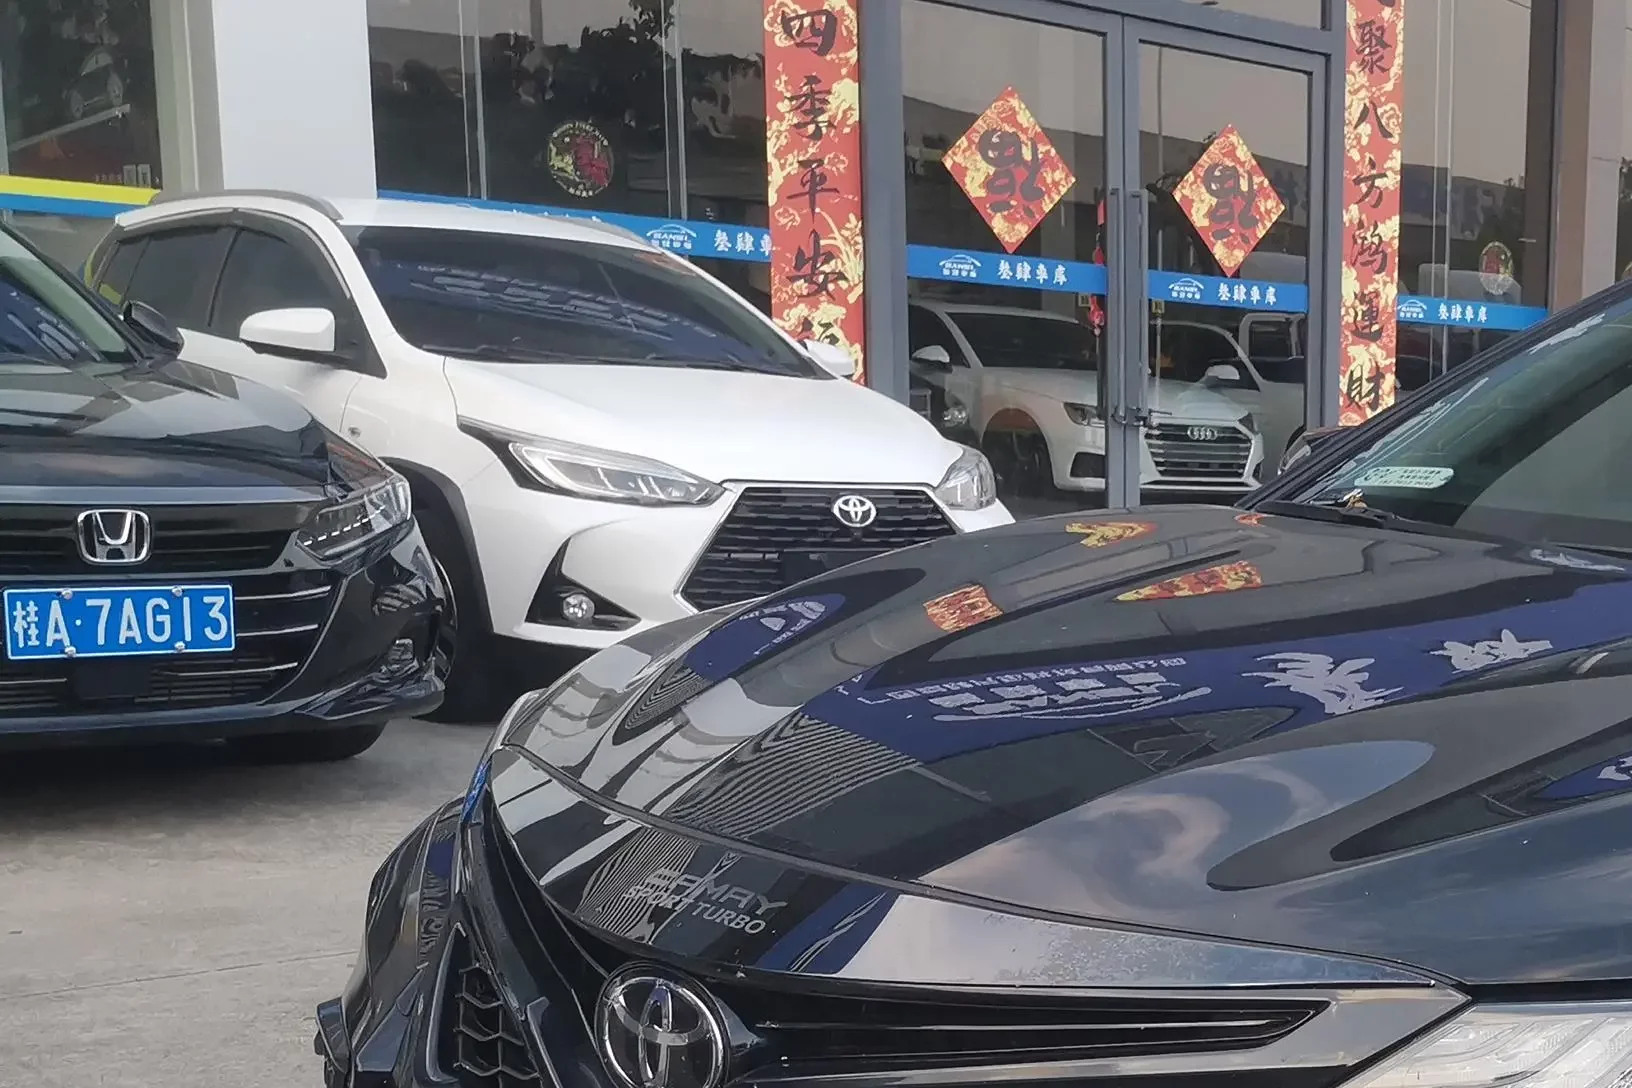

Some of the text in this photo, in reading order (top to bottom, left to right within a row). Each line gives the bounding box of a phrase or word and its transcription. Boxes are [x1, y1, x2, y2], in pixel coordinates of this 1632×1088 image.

[978, 127, 1044, 218] 福
[1203, 162, 1260, 244] 福
[691, 901, 767, 934] TURBO
